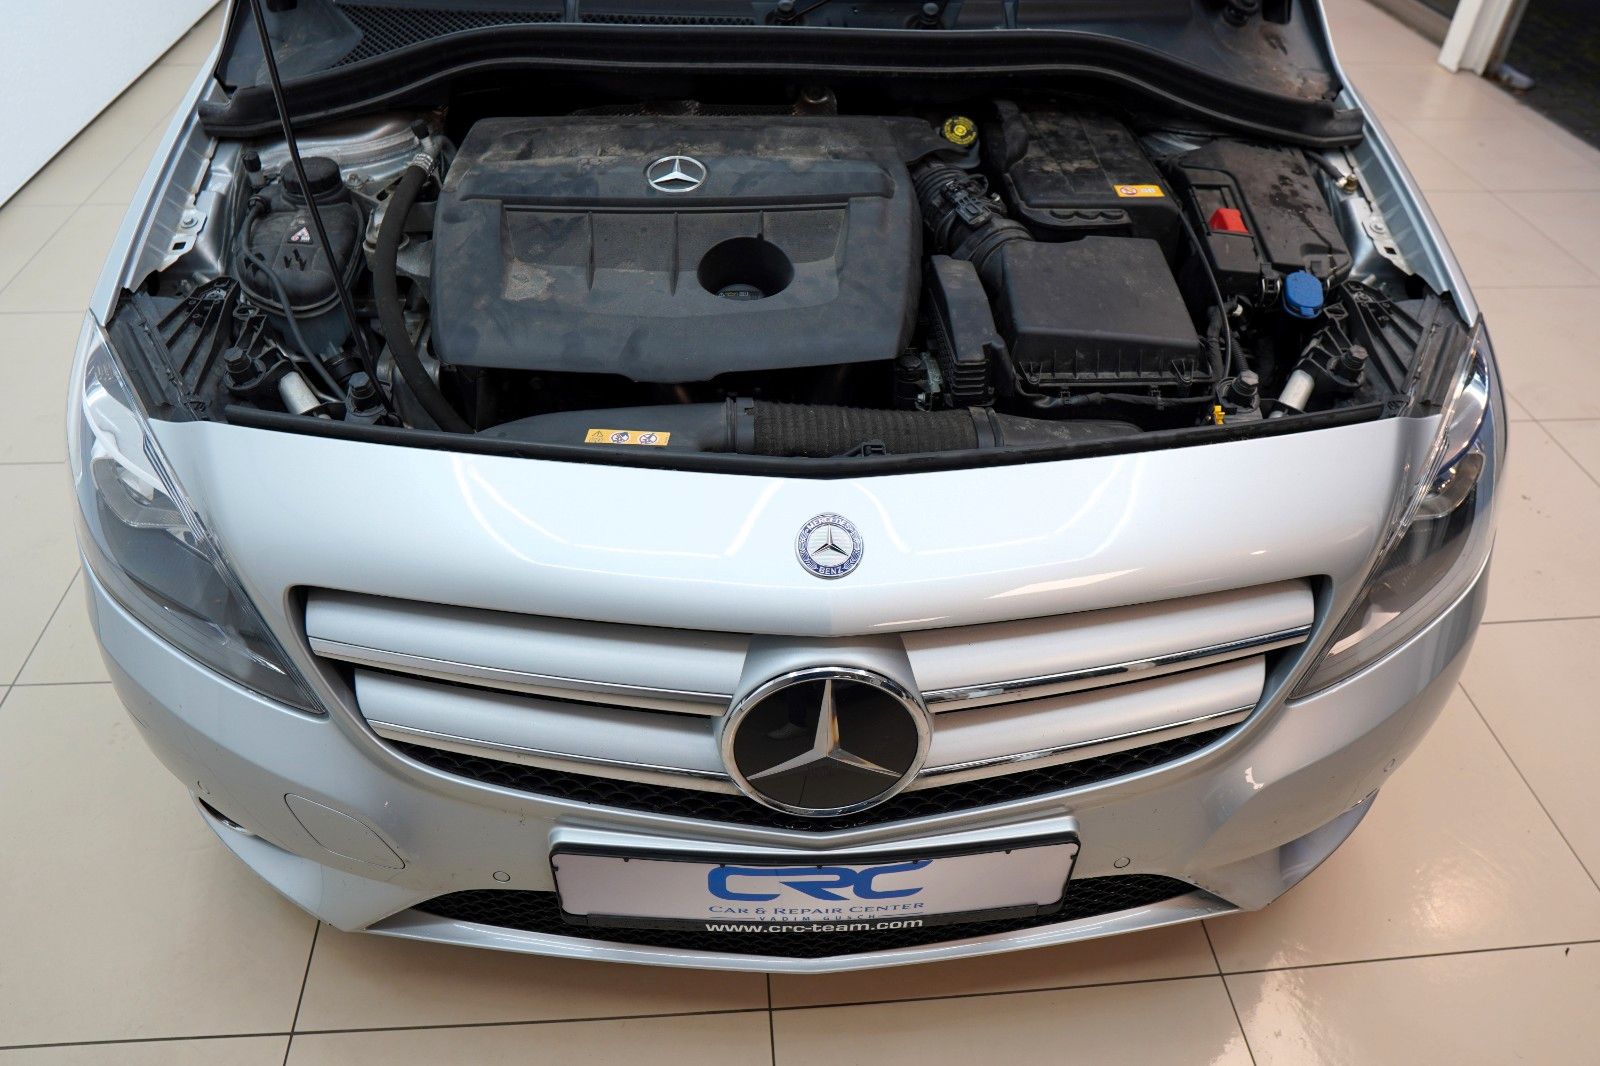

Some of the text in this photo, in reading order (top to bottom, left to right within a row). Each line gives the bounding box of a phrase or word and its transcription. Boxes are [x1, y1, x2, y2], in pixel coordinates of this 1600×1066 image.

[807, 516, 852, 530] MERCEDES
[818, 566, 844, 575] BENZ
[707, 859, 934, 902] CRC
[755, 907, 766, 915] &
[705, 919, 924, 933] www.crc-team.com
